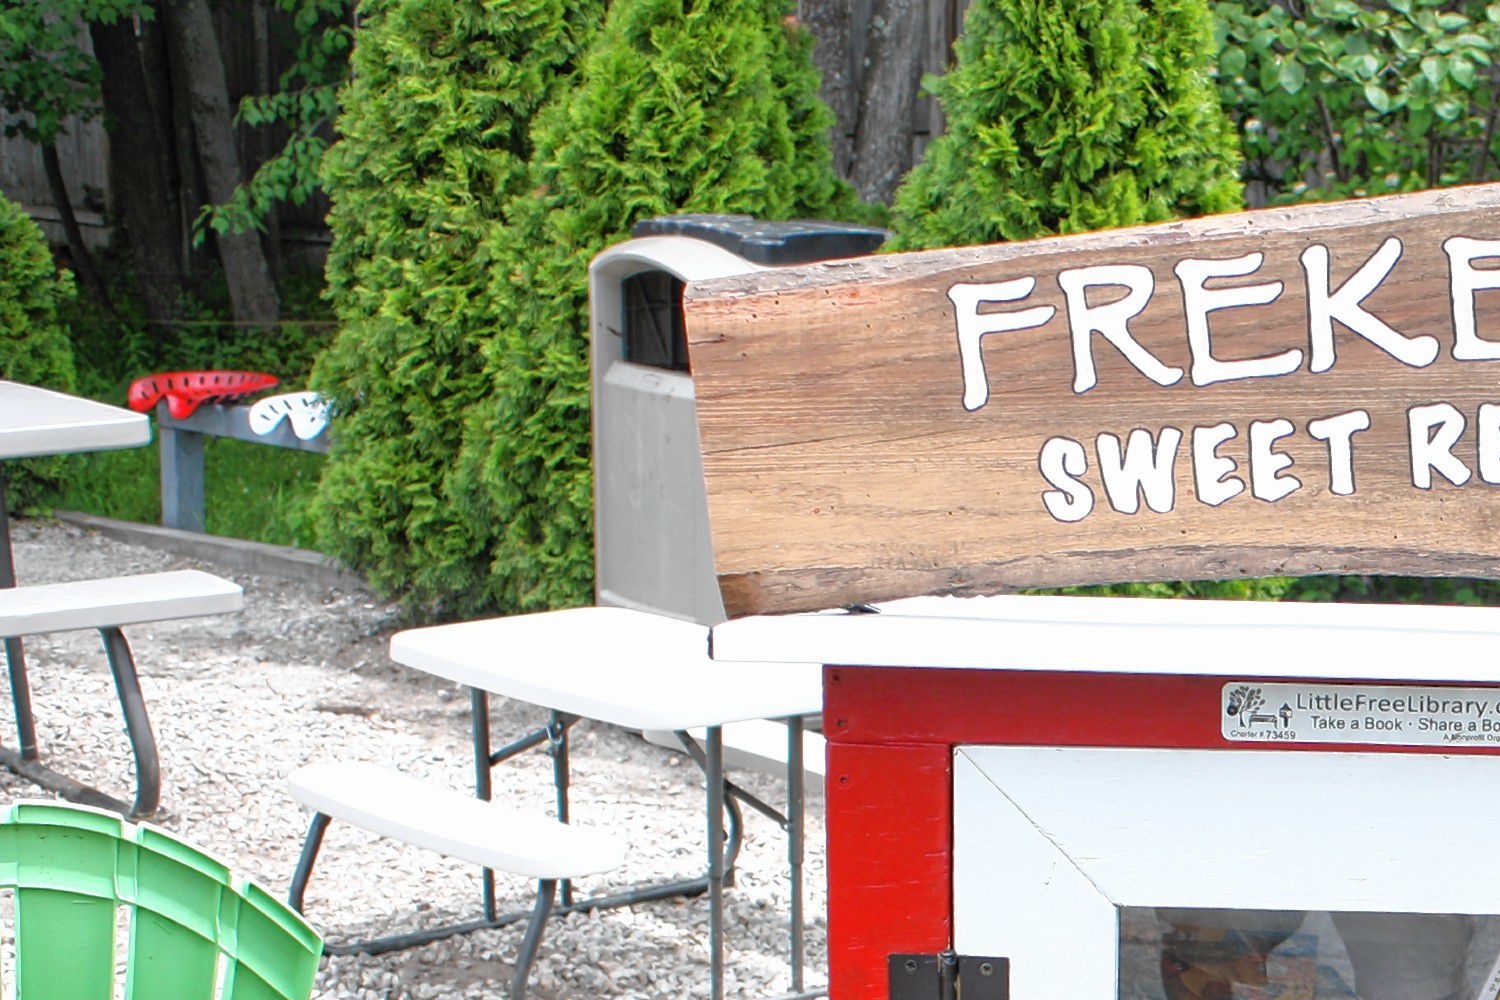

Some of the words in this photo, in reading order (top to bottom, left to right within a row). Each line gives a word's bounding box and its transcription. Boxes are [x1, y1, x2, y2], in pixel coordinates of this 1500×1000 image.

[1038, 409, 1371, 522] SWEET
[1310, 715, 1346, 730] Take
[1350, 719, 1360, 730] a
[1364, 716, 1403, 731] Book
[1417, 717, 1463, 732] Share
[1467, 722, 1477, 732] a
[1266, 730, 1297, 740] 73459
